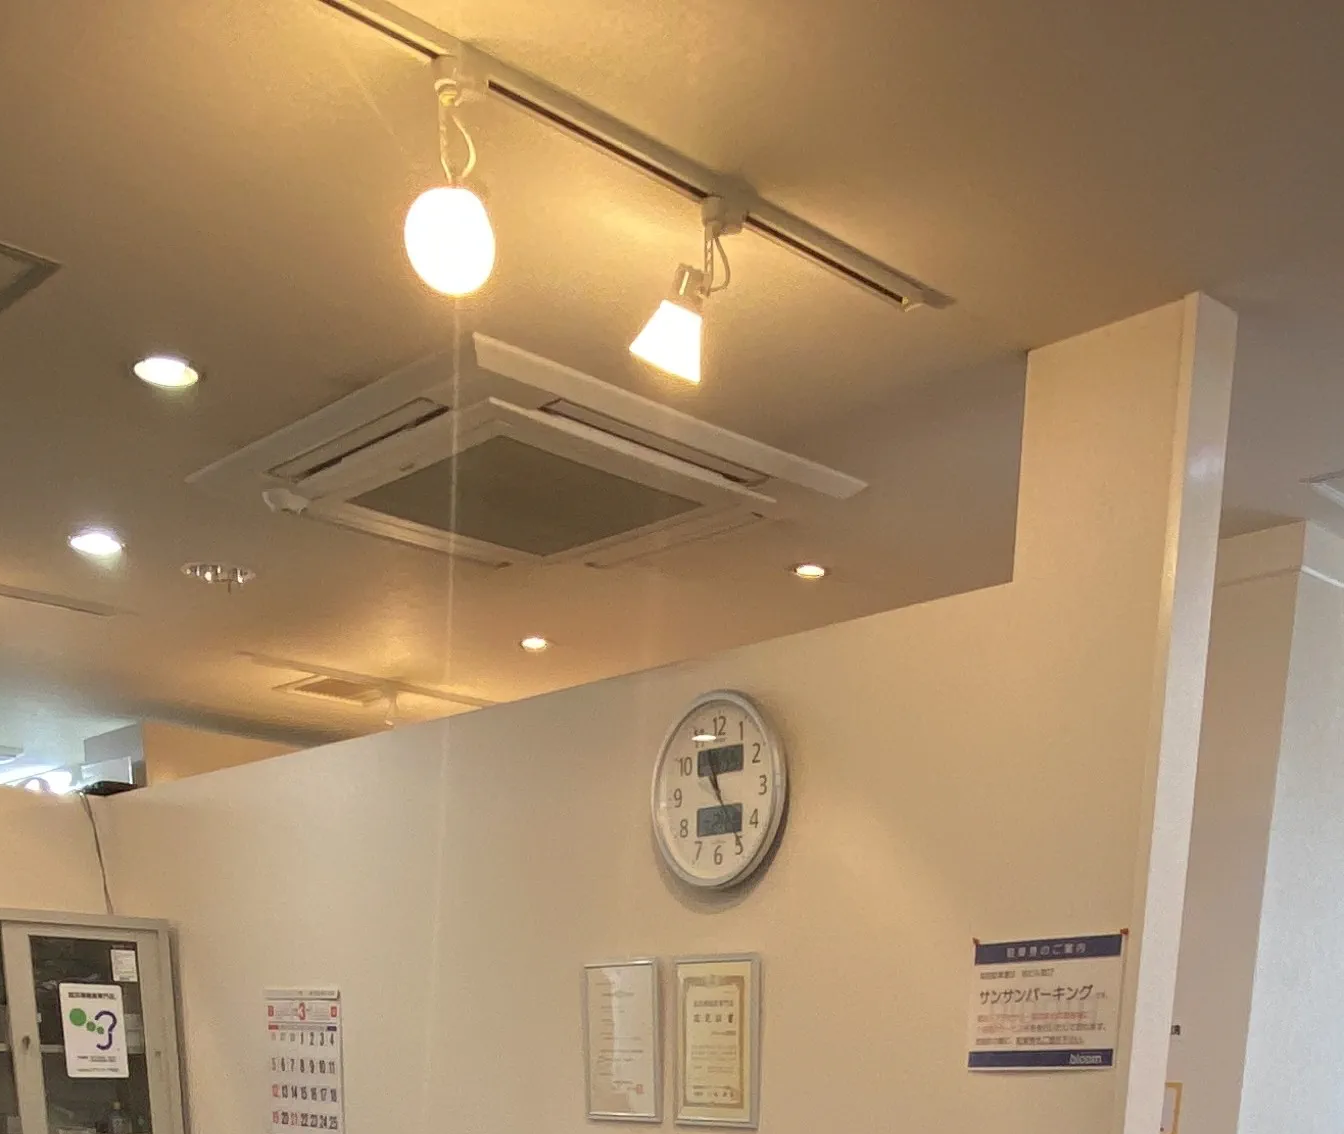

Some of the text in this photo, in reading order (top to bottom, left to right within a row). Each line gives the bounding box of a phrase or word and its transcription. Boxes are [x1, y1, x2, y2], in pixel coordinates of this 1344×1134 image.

[713, 716, 726, 735] 12
[739, 721, 743, 740] 1
[751, 743, 760, 763] 2
[679, 757, 692, 776] 10
[758, 775, 767, 795] 3
[674, 788, 682, 807] 9
[749, 808, 758, 828] 4
[680, 820, 688, 837] 8
[694, 841, 702, 860] 7
[714, 845, 722, 865] 6
